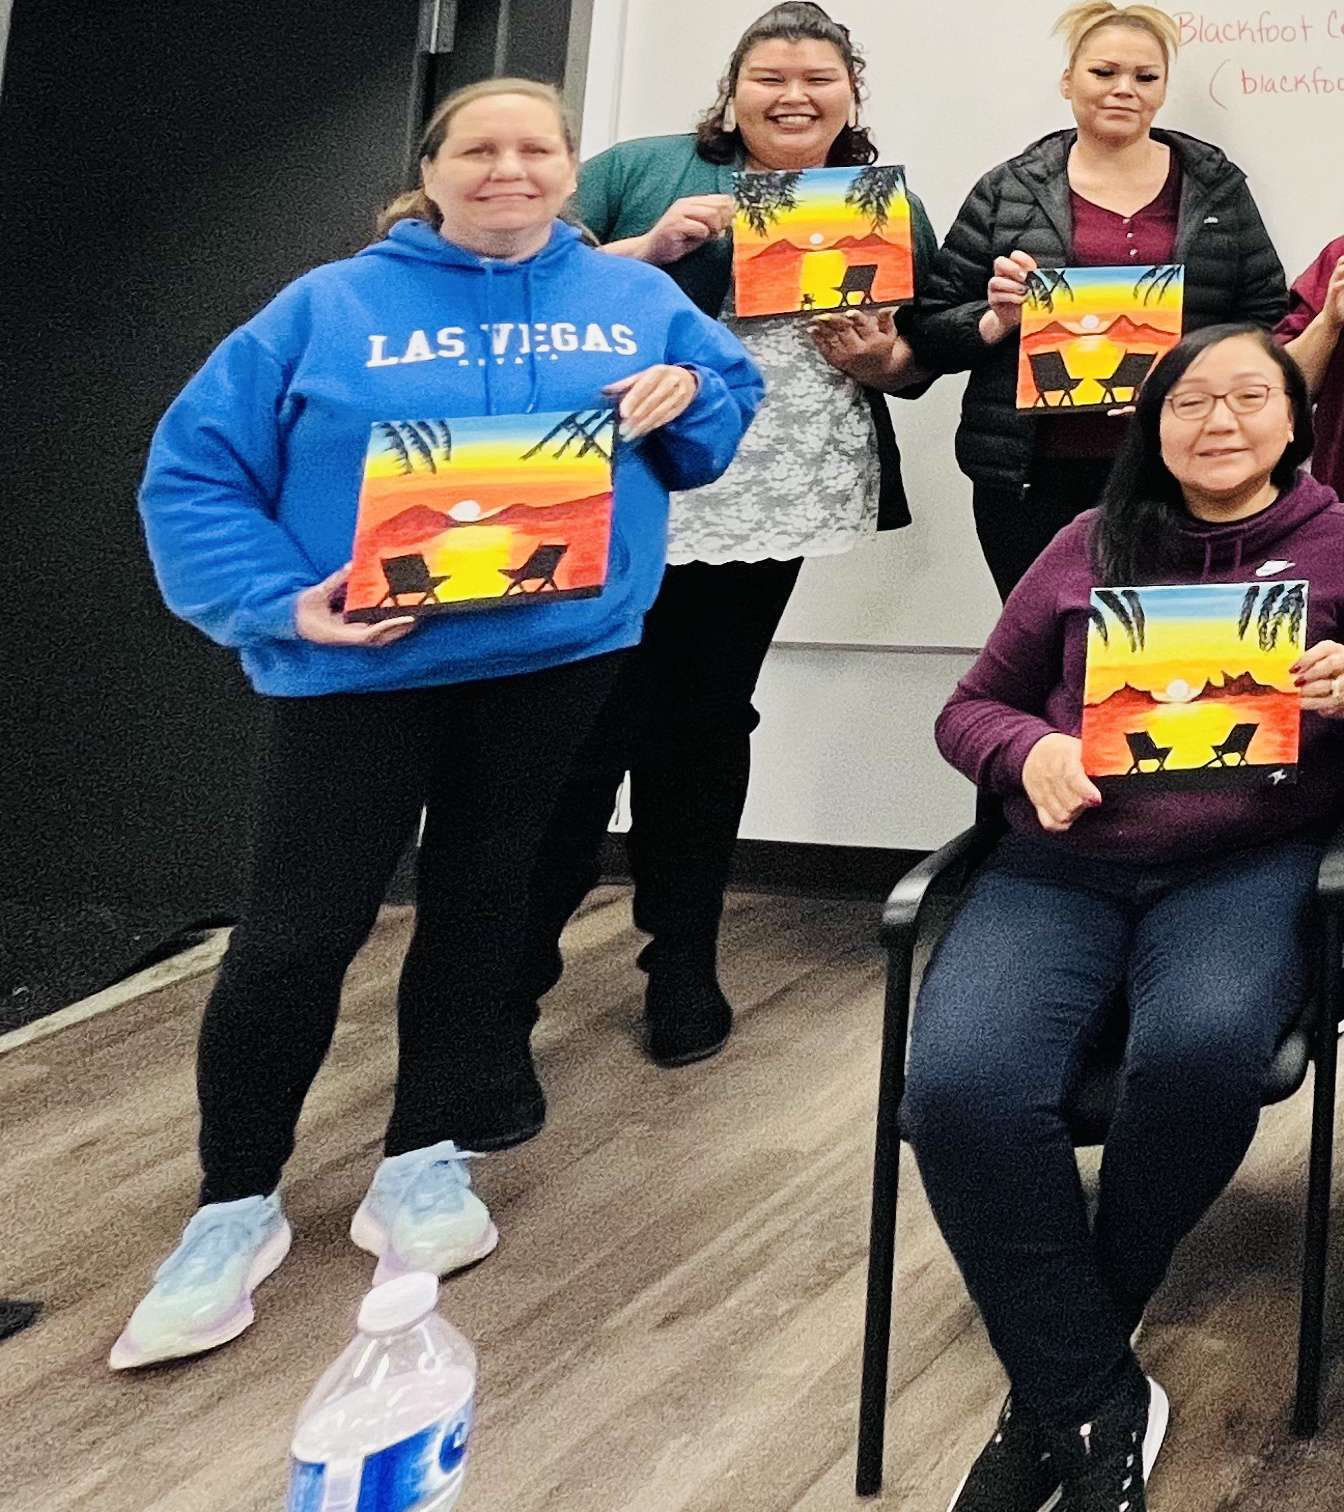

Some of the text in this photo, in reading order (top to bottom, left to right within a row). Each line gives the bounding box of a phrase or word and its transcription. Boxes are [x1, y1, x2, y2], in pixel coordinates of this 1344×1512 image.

[1172, 11, 1313, 46] Blackfoot
[366, 326, 465, 368] LAS
[480, 322, 637, 356] VEGAS
